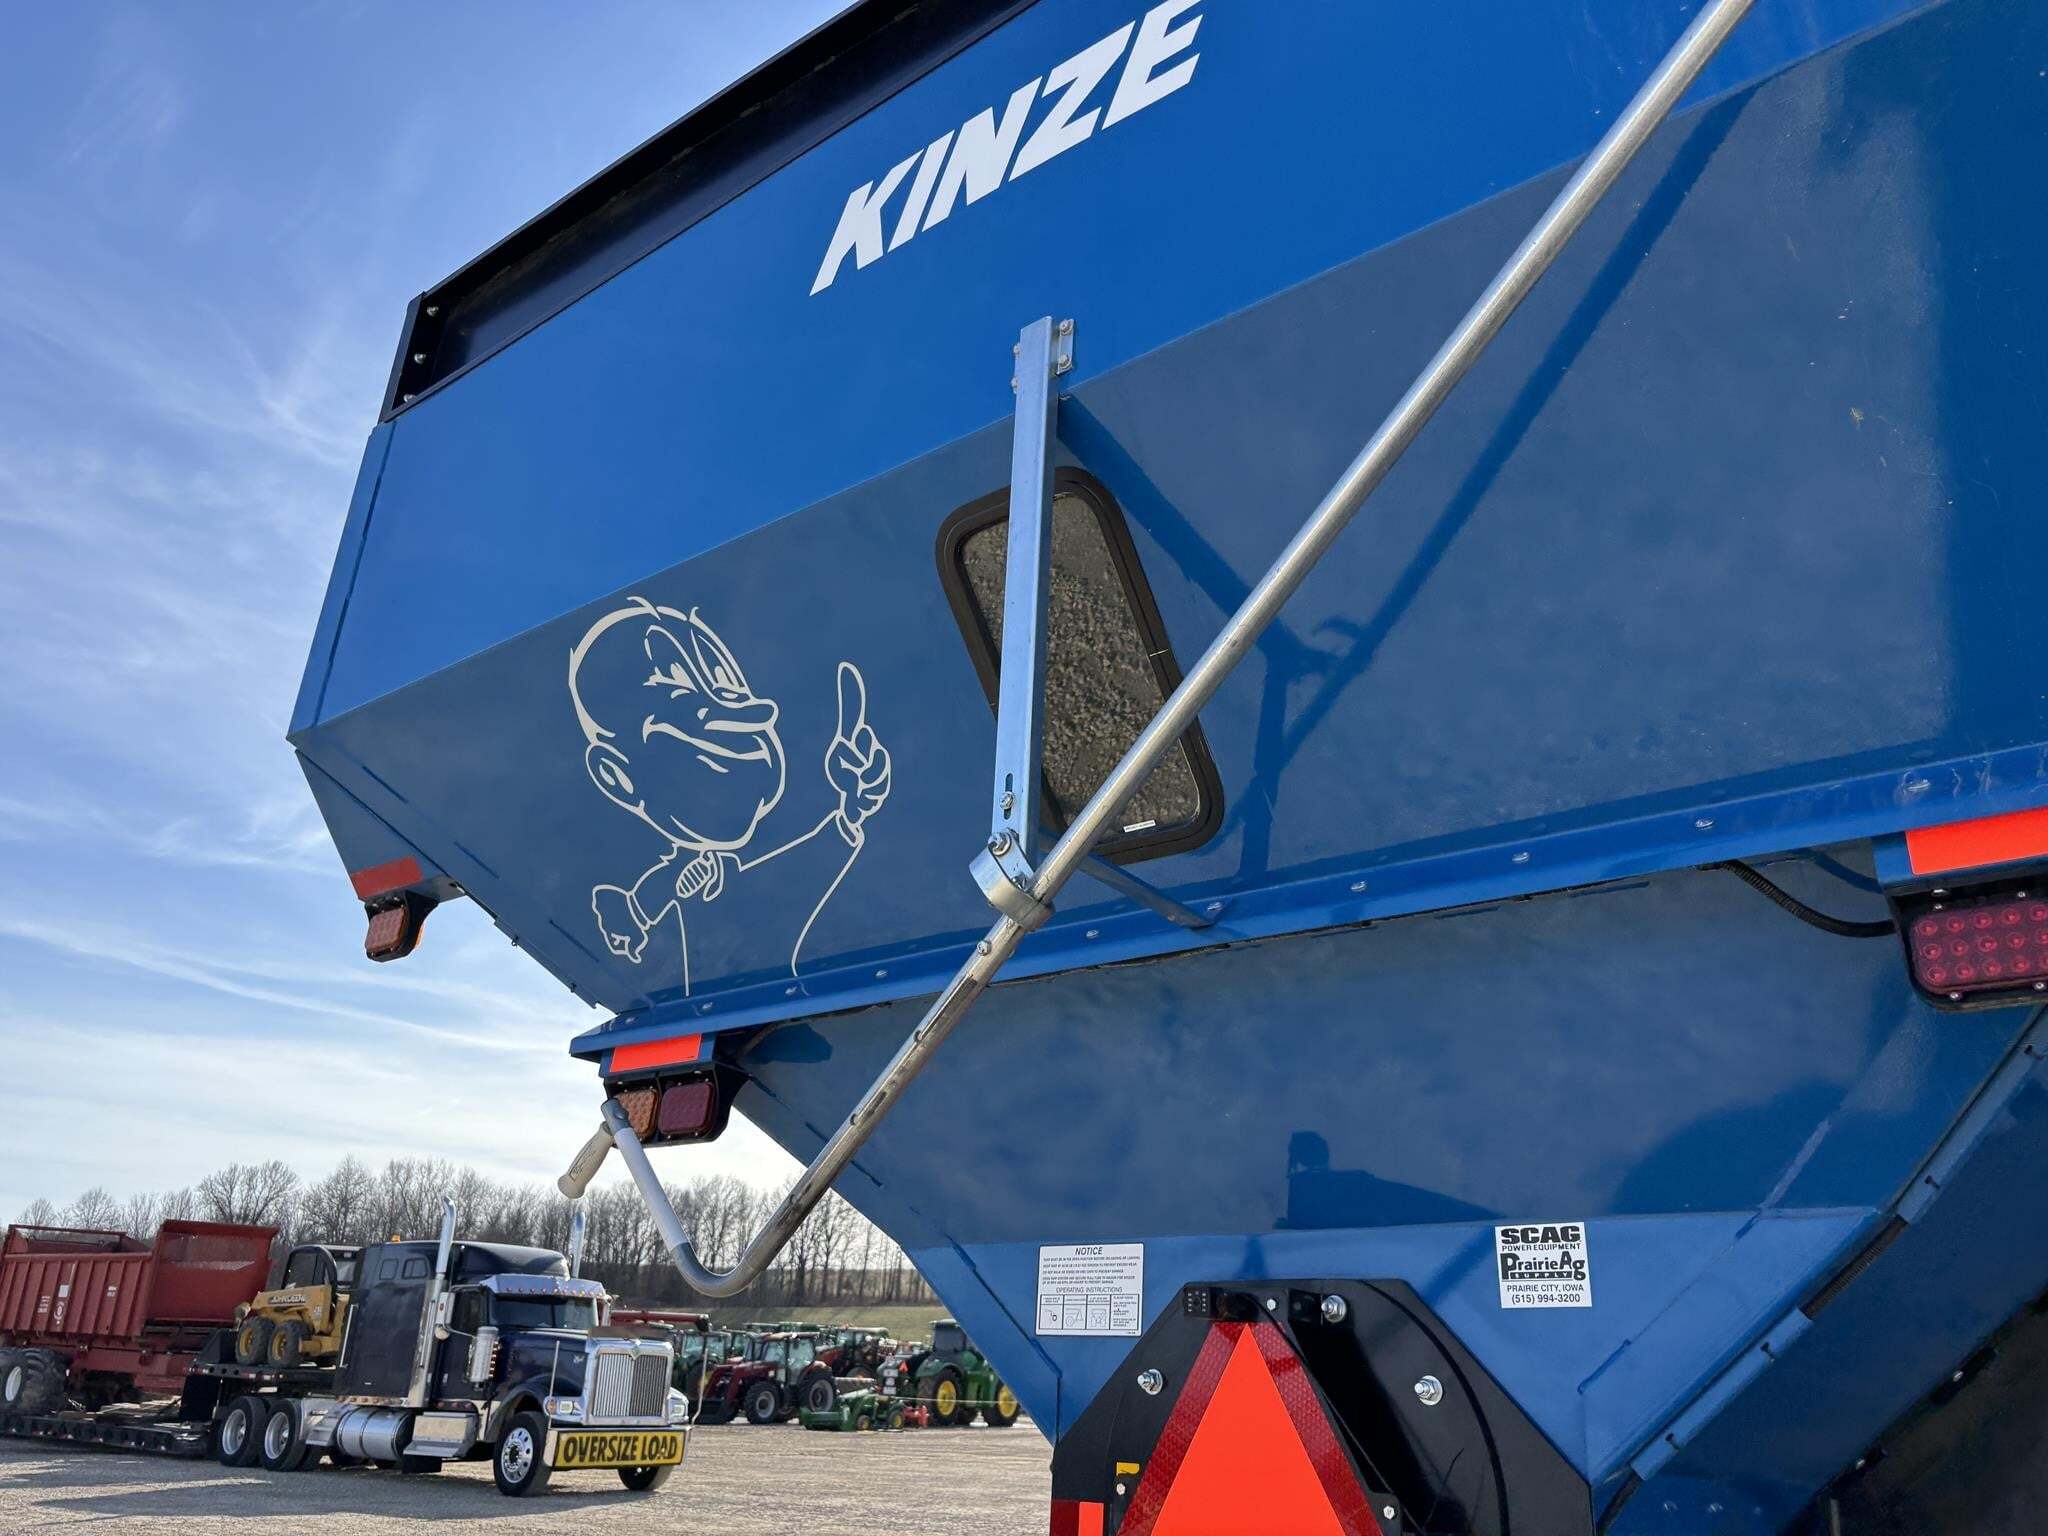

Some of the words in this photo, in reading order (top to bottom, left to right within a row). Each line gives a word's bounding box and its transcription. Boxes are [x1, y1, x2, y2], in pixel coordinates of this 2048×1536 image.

[809, 0, 1203, 297] KINZE
[1501, 1225, 1581, 1244] SCAG
[1075, 1246, 1103, 1256] NOTICE
[1502, 1244, 1532, 1252] POWER
[1533, 1242, 1581, 1251] EQUIPMENT
[1507, 1284, 1539, 1292] PRAIRIE
[1540, 1284, 1561, 1293] CITY,
[1562, 1283, 1584, 1292] IOWA
[1511, 1294, 1535, 1305] (515)
[1537, 1293, 1581, 1303] 994-3200
[563, 1435, 639, 1463] OVERSIZE
[640, 1434, 678, 1461] LOAD
